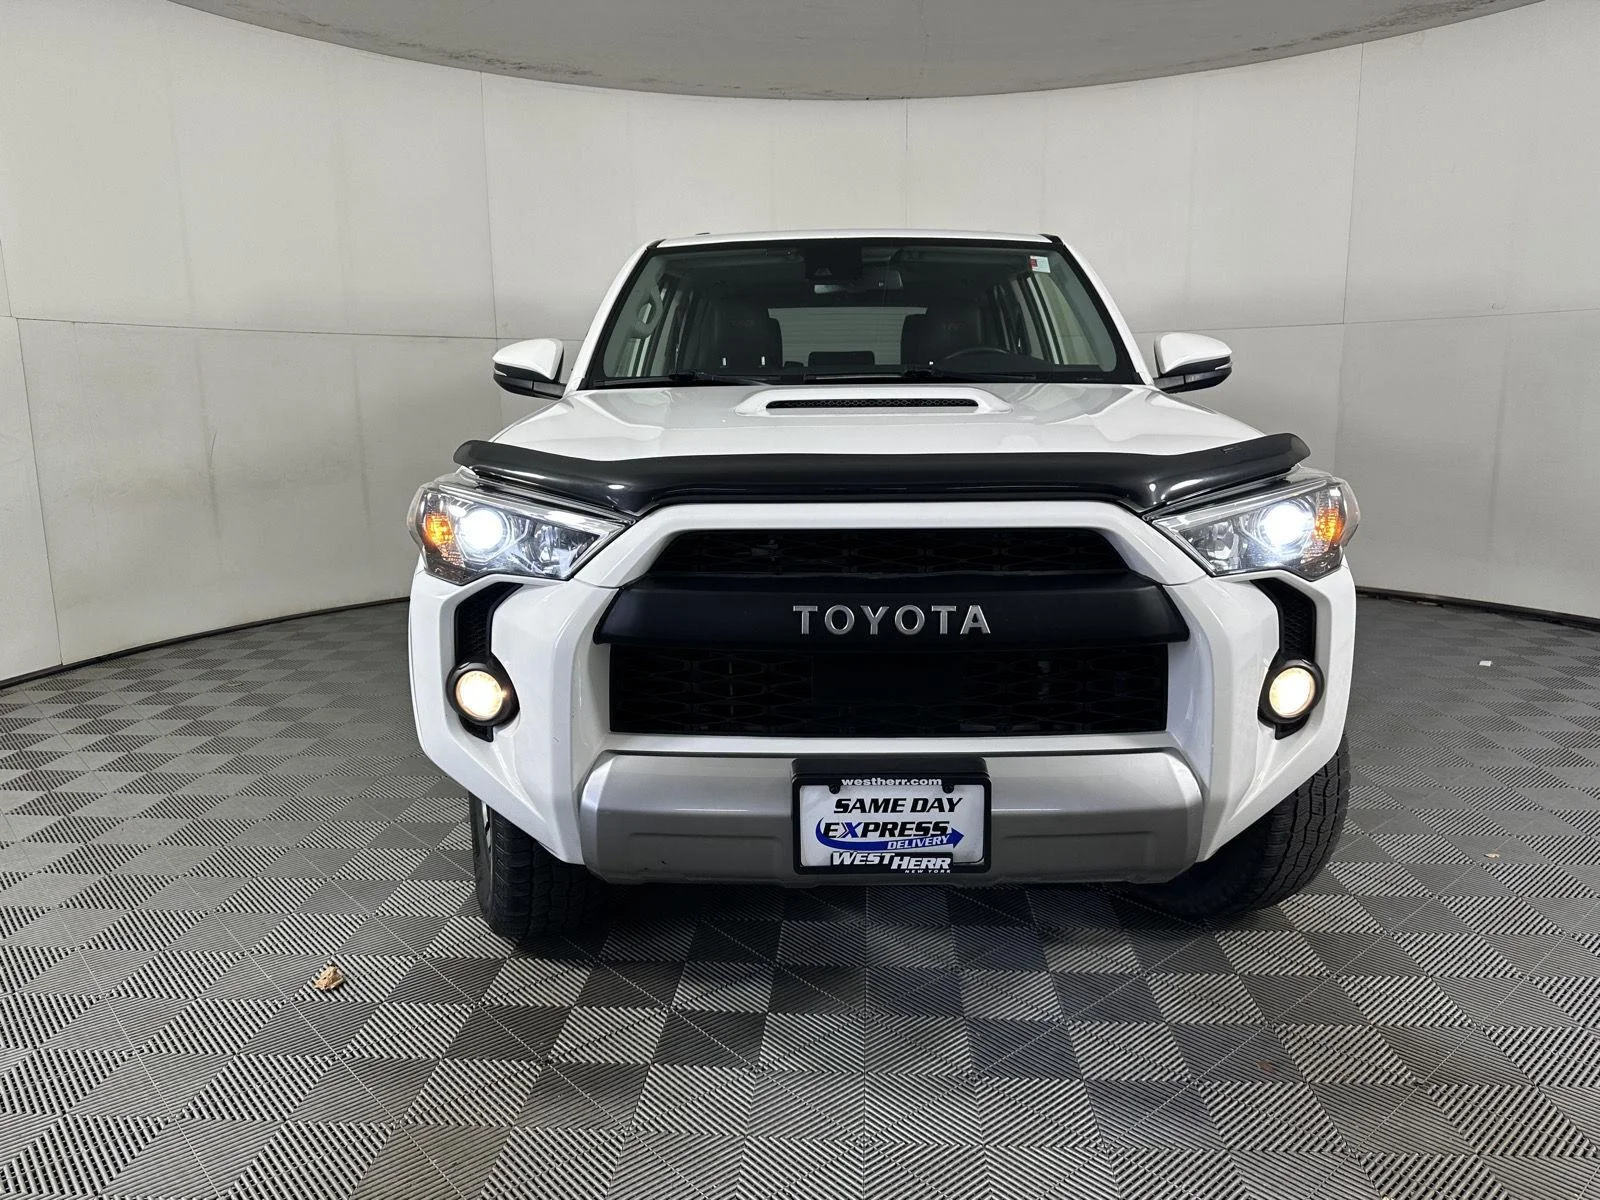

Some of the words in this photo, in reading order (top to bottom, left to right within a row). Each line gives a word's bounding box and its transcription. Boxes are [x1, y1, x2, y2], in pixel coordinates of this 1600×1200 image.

[793, 604, 991, 635] TOYOTA
[841, 777, 942, 786] westherr.com
[833, 797, 907, 814] SAME
[909, 797, 963, 813] DAY
[823, 821, 950, 839] EXPRESS
[886, 835, 951, 850] DELIVERY
